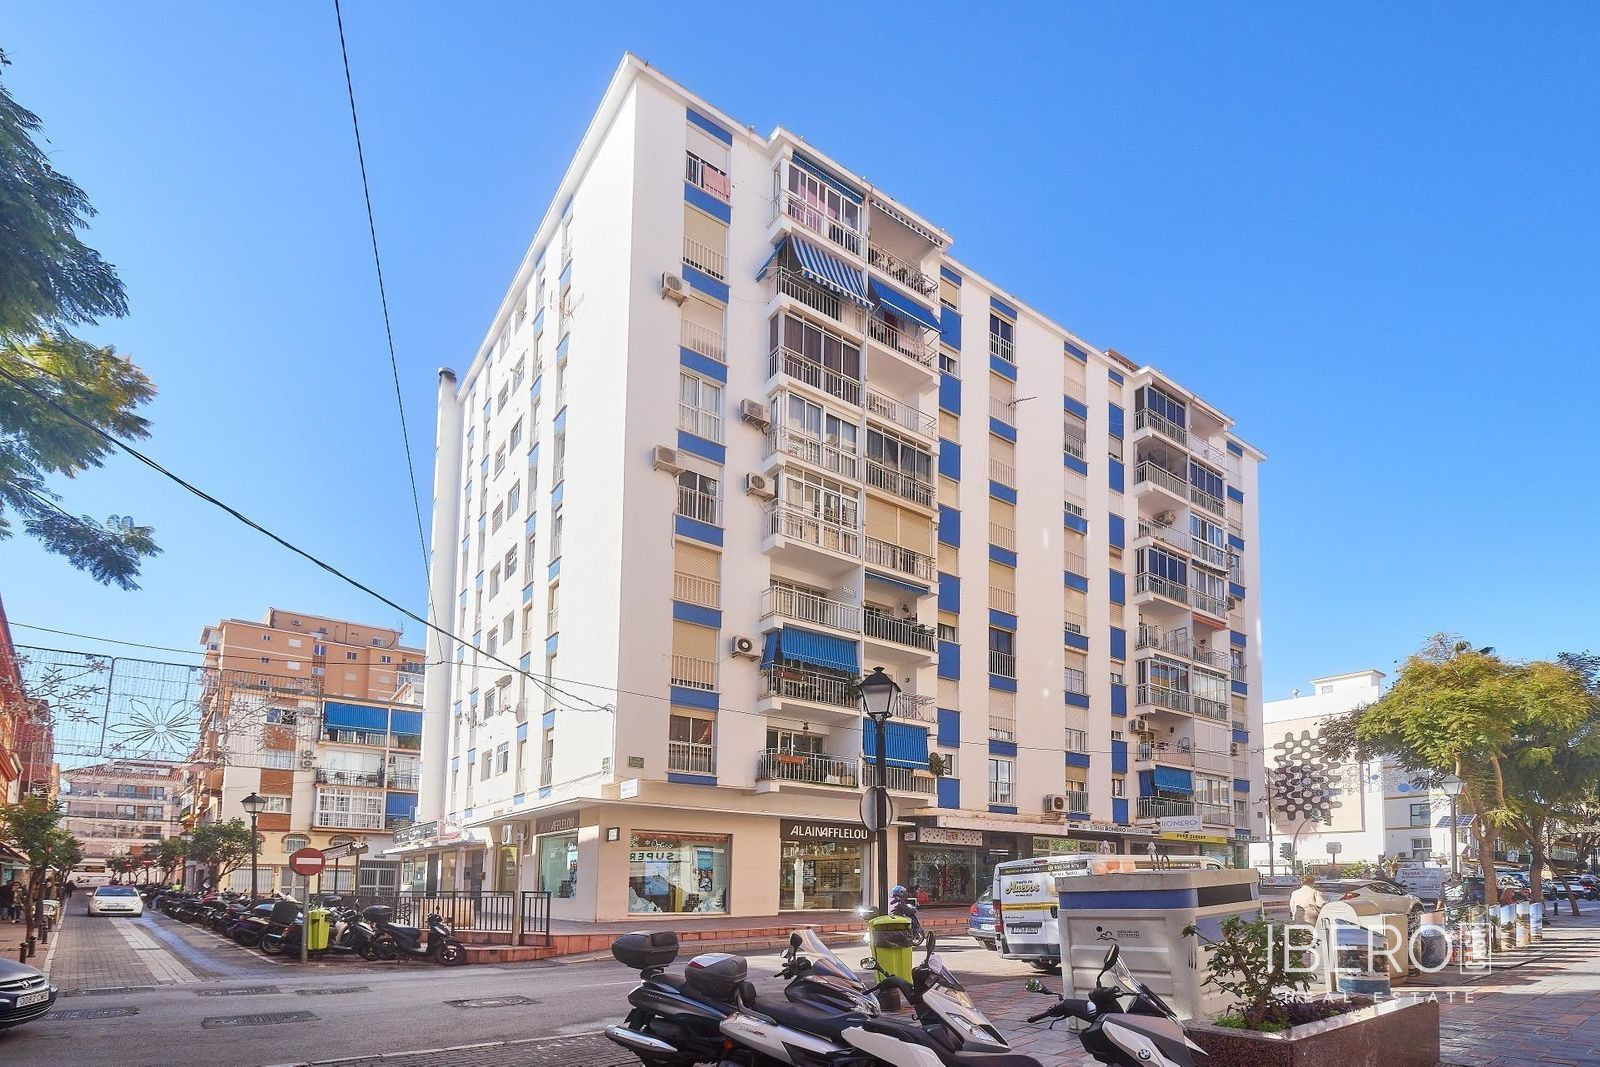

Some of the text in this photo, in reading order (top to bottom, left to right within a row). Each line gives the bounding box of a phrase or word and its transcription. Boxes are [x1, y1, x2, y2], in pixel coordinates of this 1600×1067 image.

[1161, 819, 1197, 827] ROMERO
[790, 825, 868, 840] ALAIN AFFLELOU
